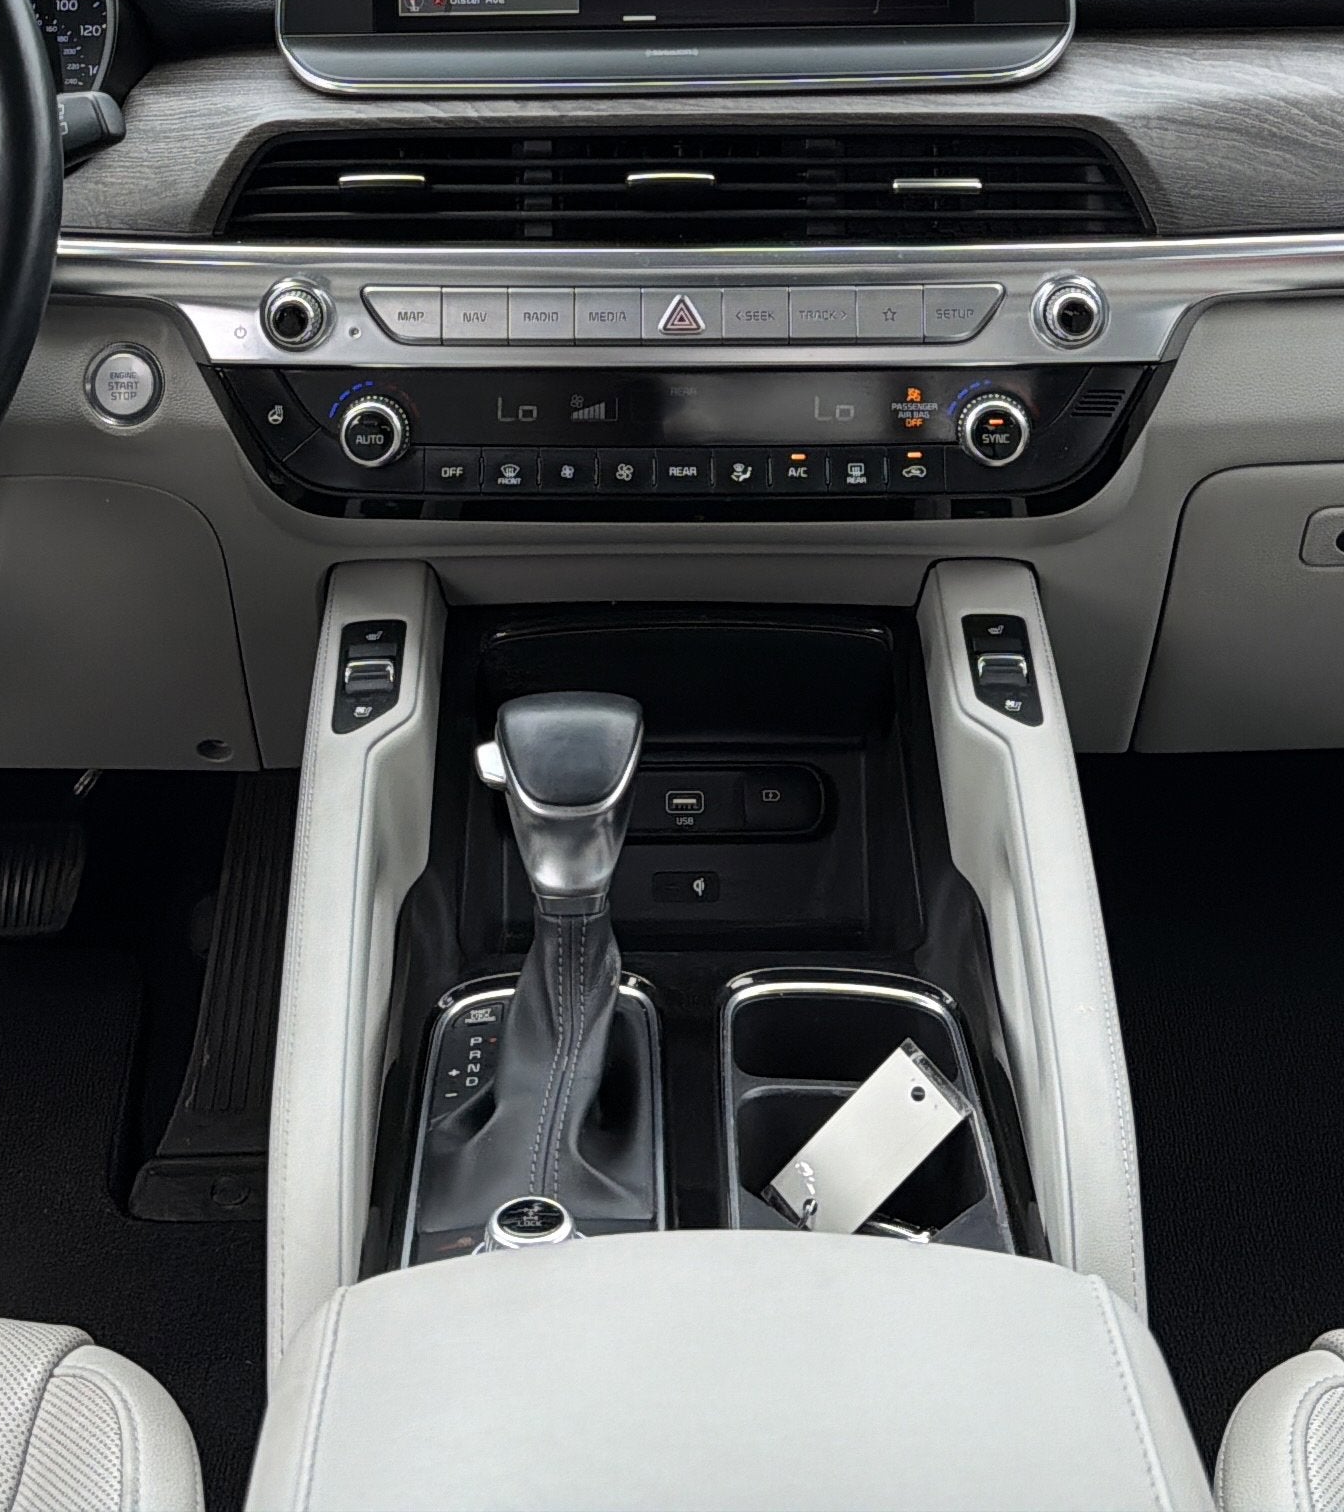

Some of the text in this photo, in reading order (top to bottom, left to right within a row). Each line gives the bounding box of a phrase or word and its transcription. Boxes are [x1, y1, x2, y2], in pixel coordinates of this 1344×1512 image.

[56, 0, 78, 11] 100
[80, 24, 102, 36] 120
[397, 310, 425, 323] MAP
[462, 311, 488, 323] NAV
[523, 311, 559, 323] RADIO
[588, 310, 627, 322] MEDIA
[935, 307, 975, 320] SETUP
[109, 371, 137, 380] ENGINE
[108, 381, 139, 391] START
[110, 391, 137, 401] STOP
[891, 402, 939, 411] PASSENGER
[905, 418, 924, 427] OFF
[355, 434, 384, 445] AUTO
[981, 433, 1010, 444] SYNC
[441, 466, 463, 477] OFF
[668, 466, 697, 477] REAR
[788, 466, 808, 478] A/C
[497, 477, 522, 486] FRONT
[846, 475, 867, 484] REAR
[675, 816, 695, 826] USB
[469, 1036, 483, 1047] P
[468, 1050, 481, 1060] R
[467, 1063, 481, 1074] N
[465, 1076, 479, 1087] D
[517, 1219, 543, 1228] LOCK
